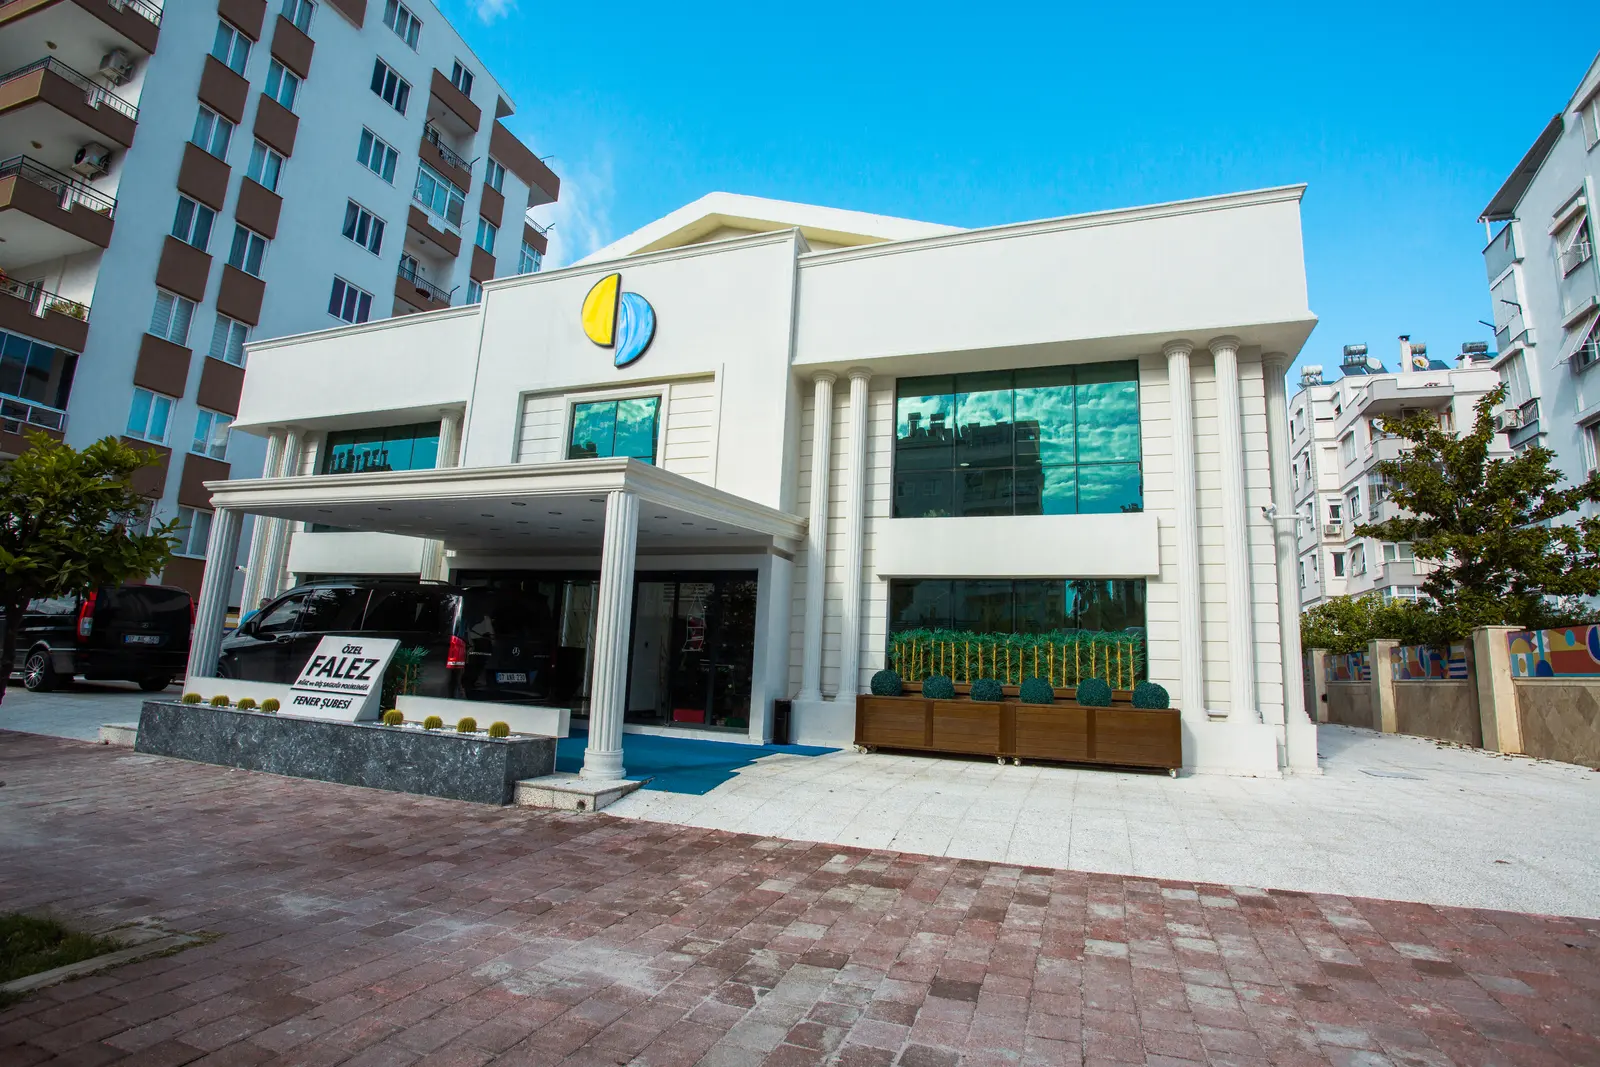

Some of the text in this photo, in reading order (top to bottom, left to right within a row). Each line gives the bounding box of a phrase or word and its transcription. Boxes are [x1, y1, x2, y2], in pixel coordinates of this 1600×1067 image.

[342, 644, 363, 655] ÖZEL
[305, 655, 380, 681] FALEZ
[293, 695, 353, 710] FENER ŞUBESİ
